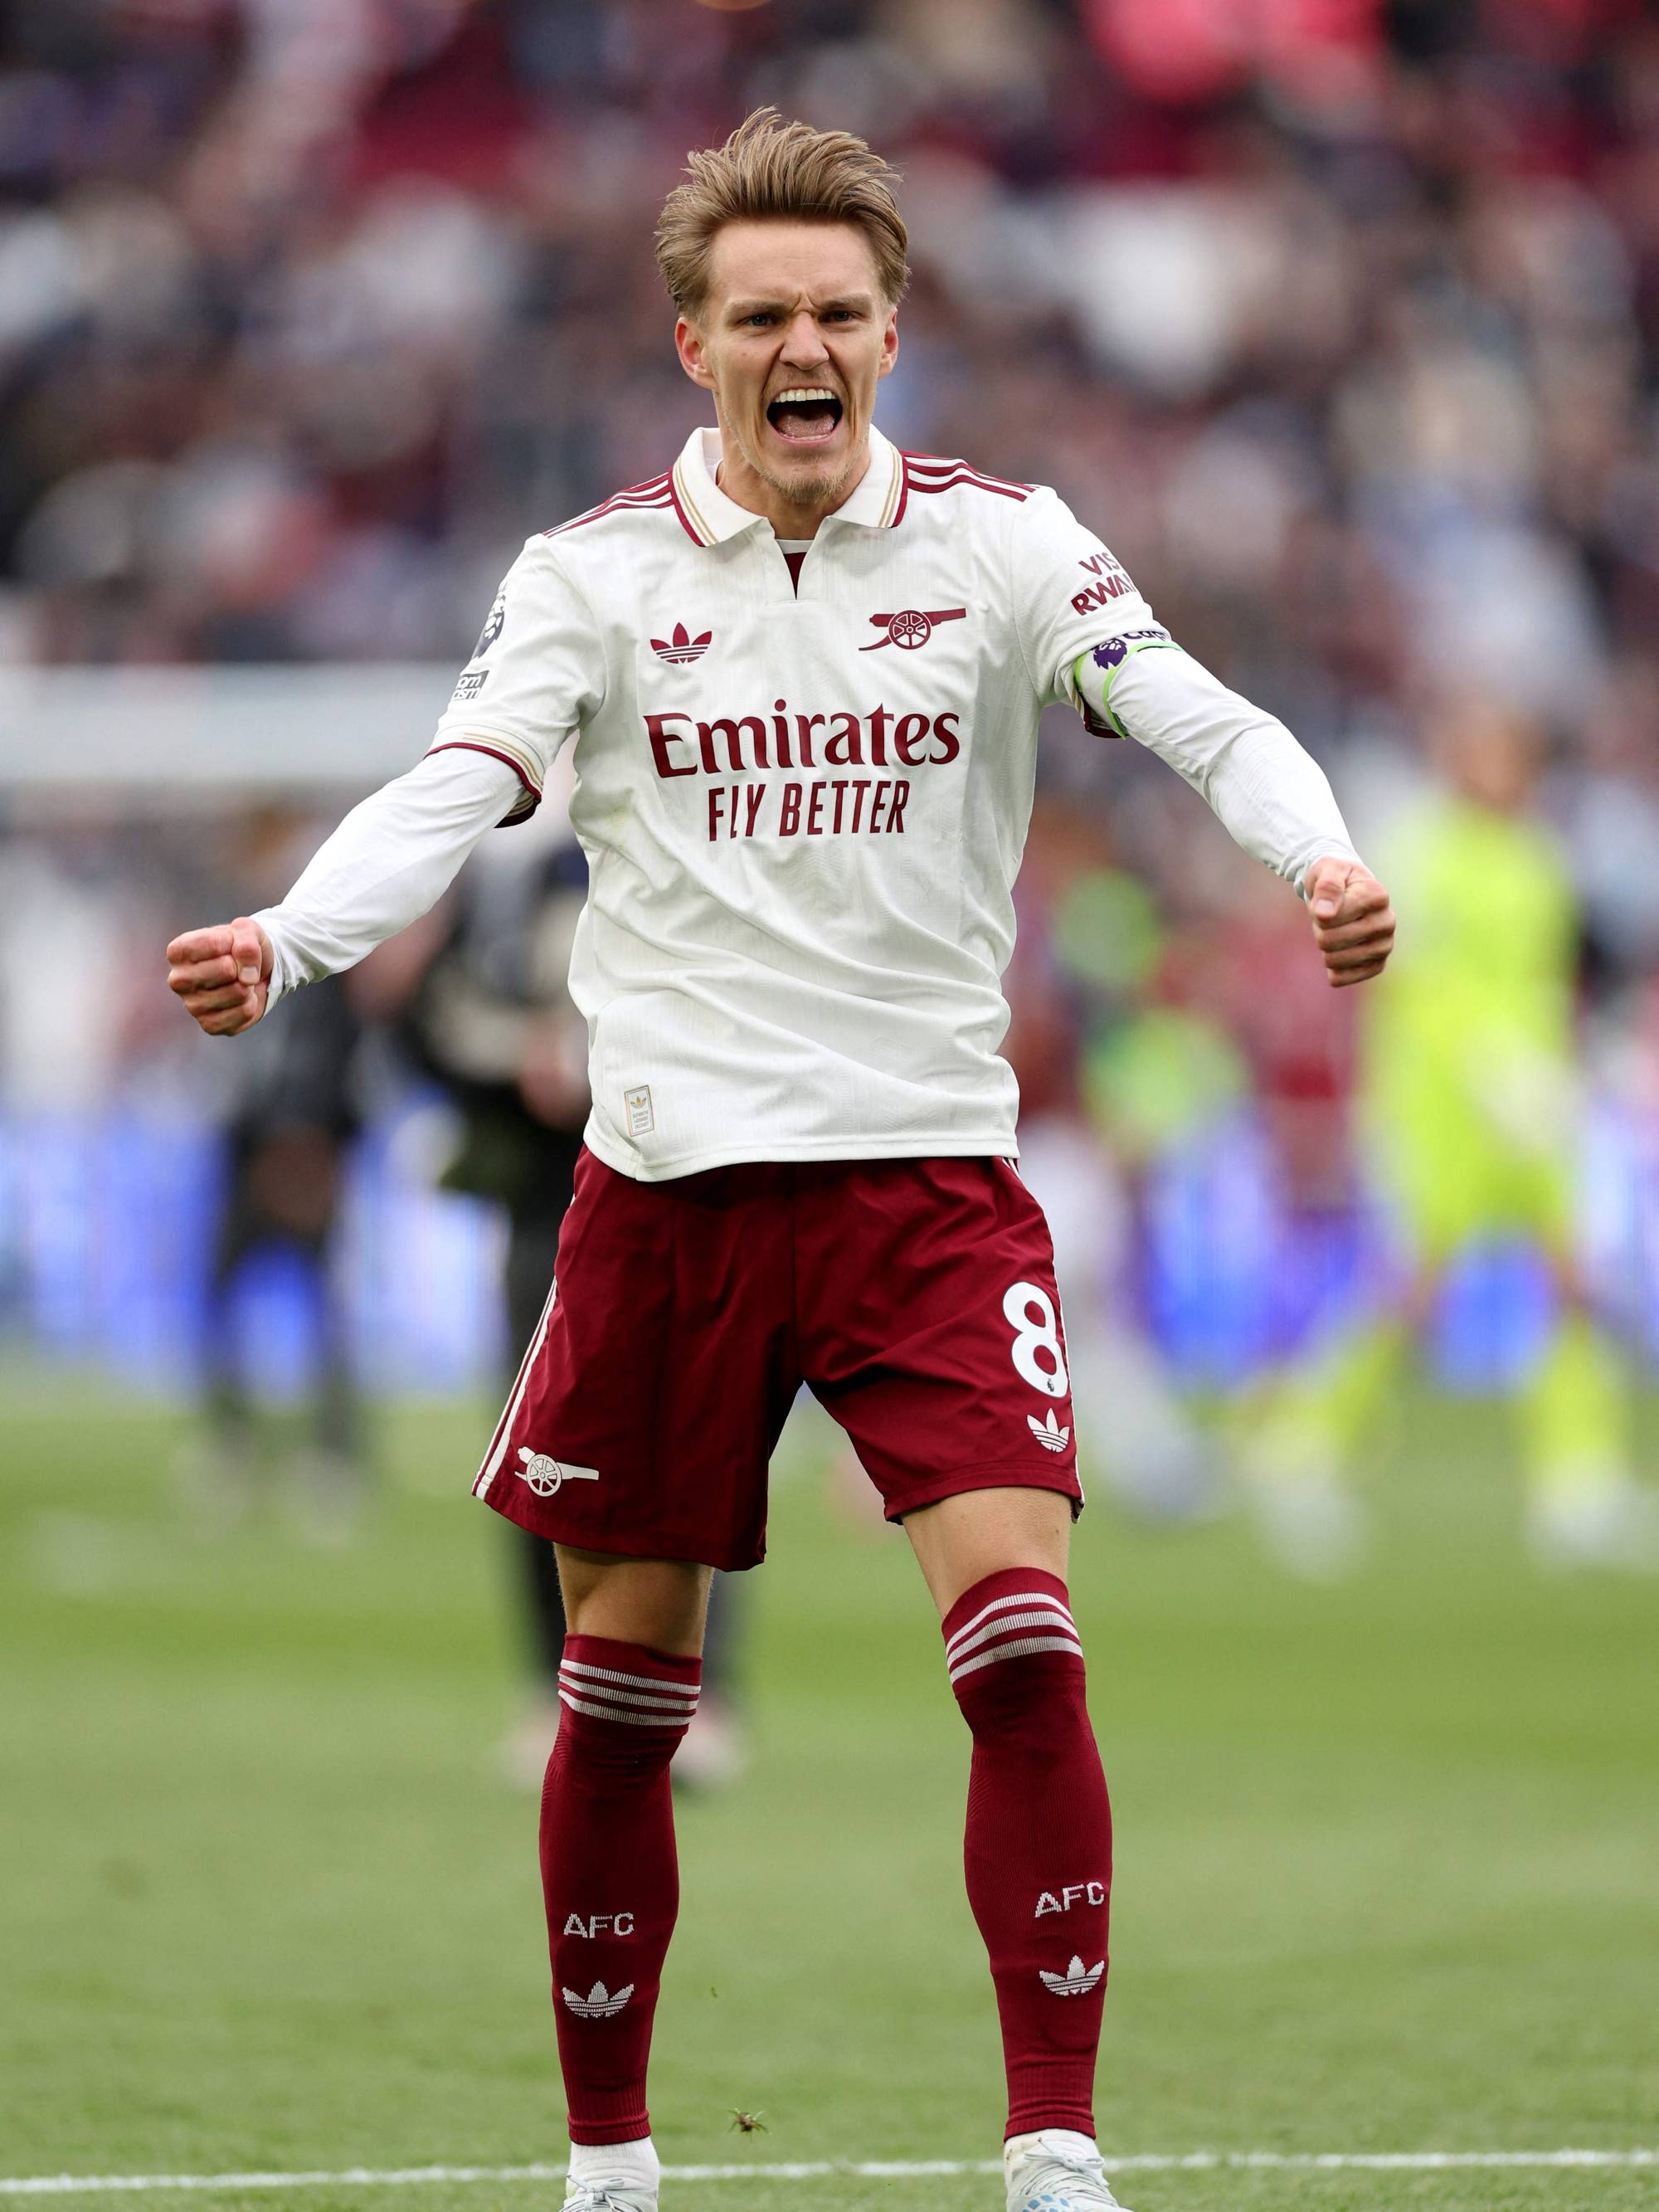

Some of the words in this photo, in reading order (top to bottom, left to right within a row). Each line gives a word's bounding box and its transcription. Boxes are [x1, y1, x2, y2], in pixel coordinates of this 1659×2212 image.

[643, 699, 960, 778] Emirates
[708, 783, 766, 842] FLY
[779, 780, 910, 836] BETTER
[1003, 1282, 1068, 1398] 8
[563, 1912, 635, 1938] AFC
[1034, 1882, 1104, 1918] AFC
